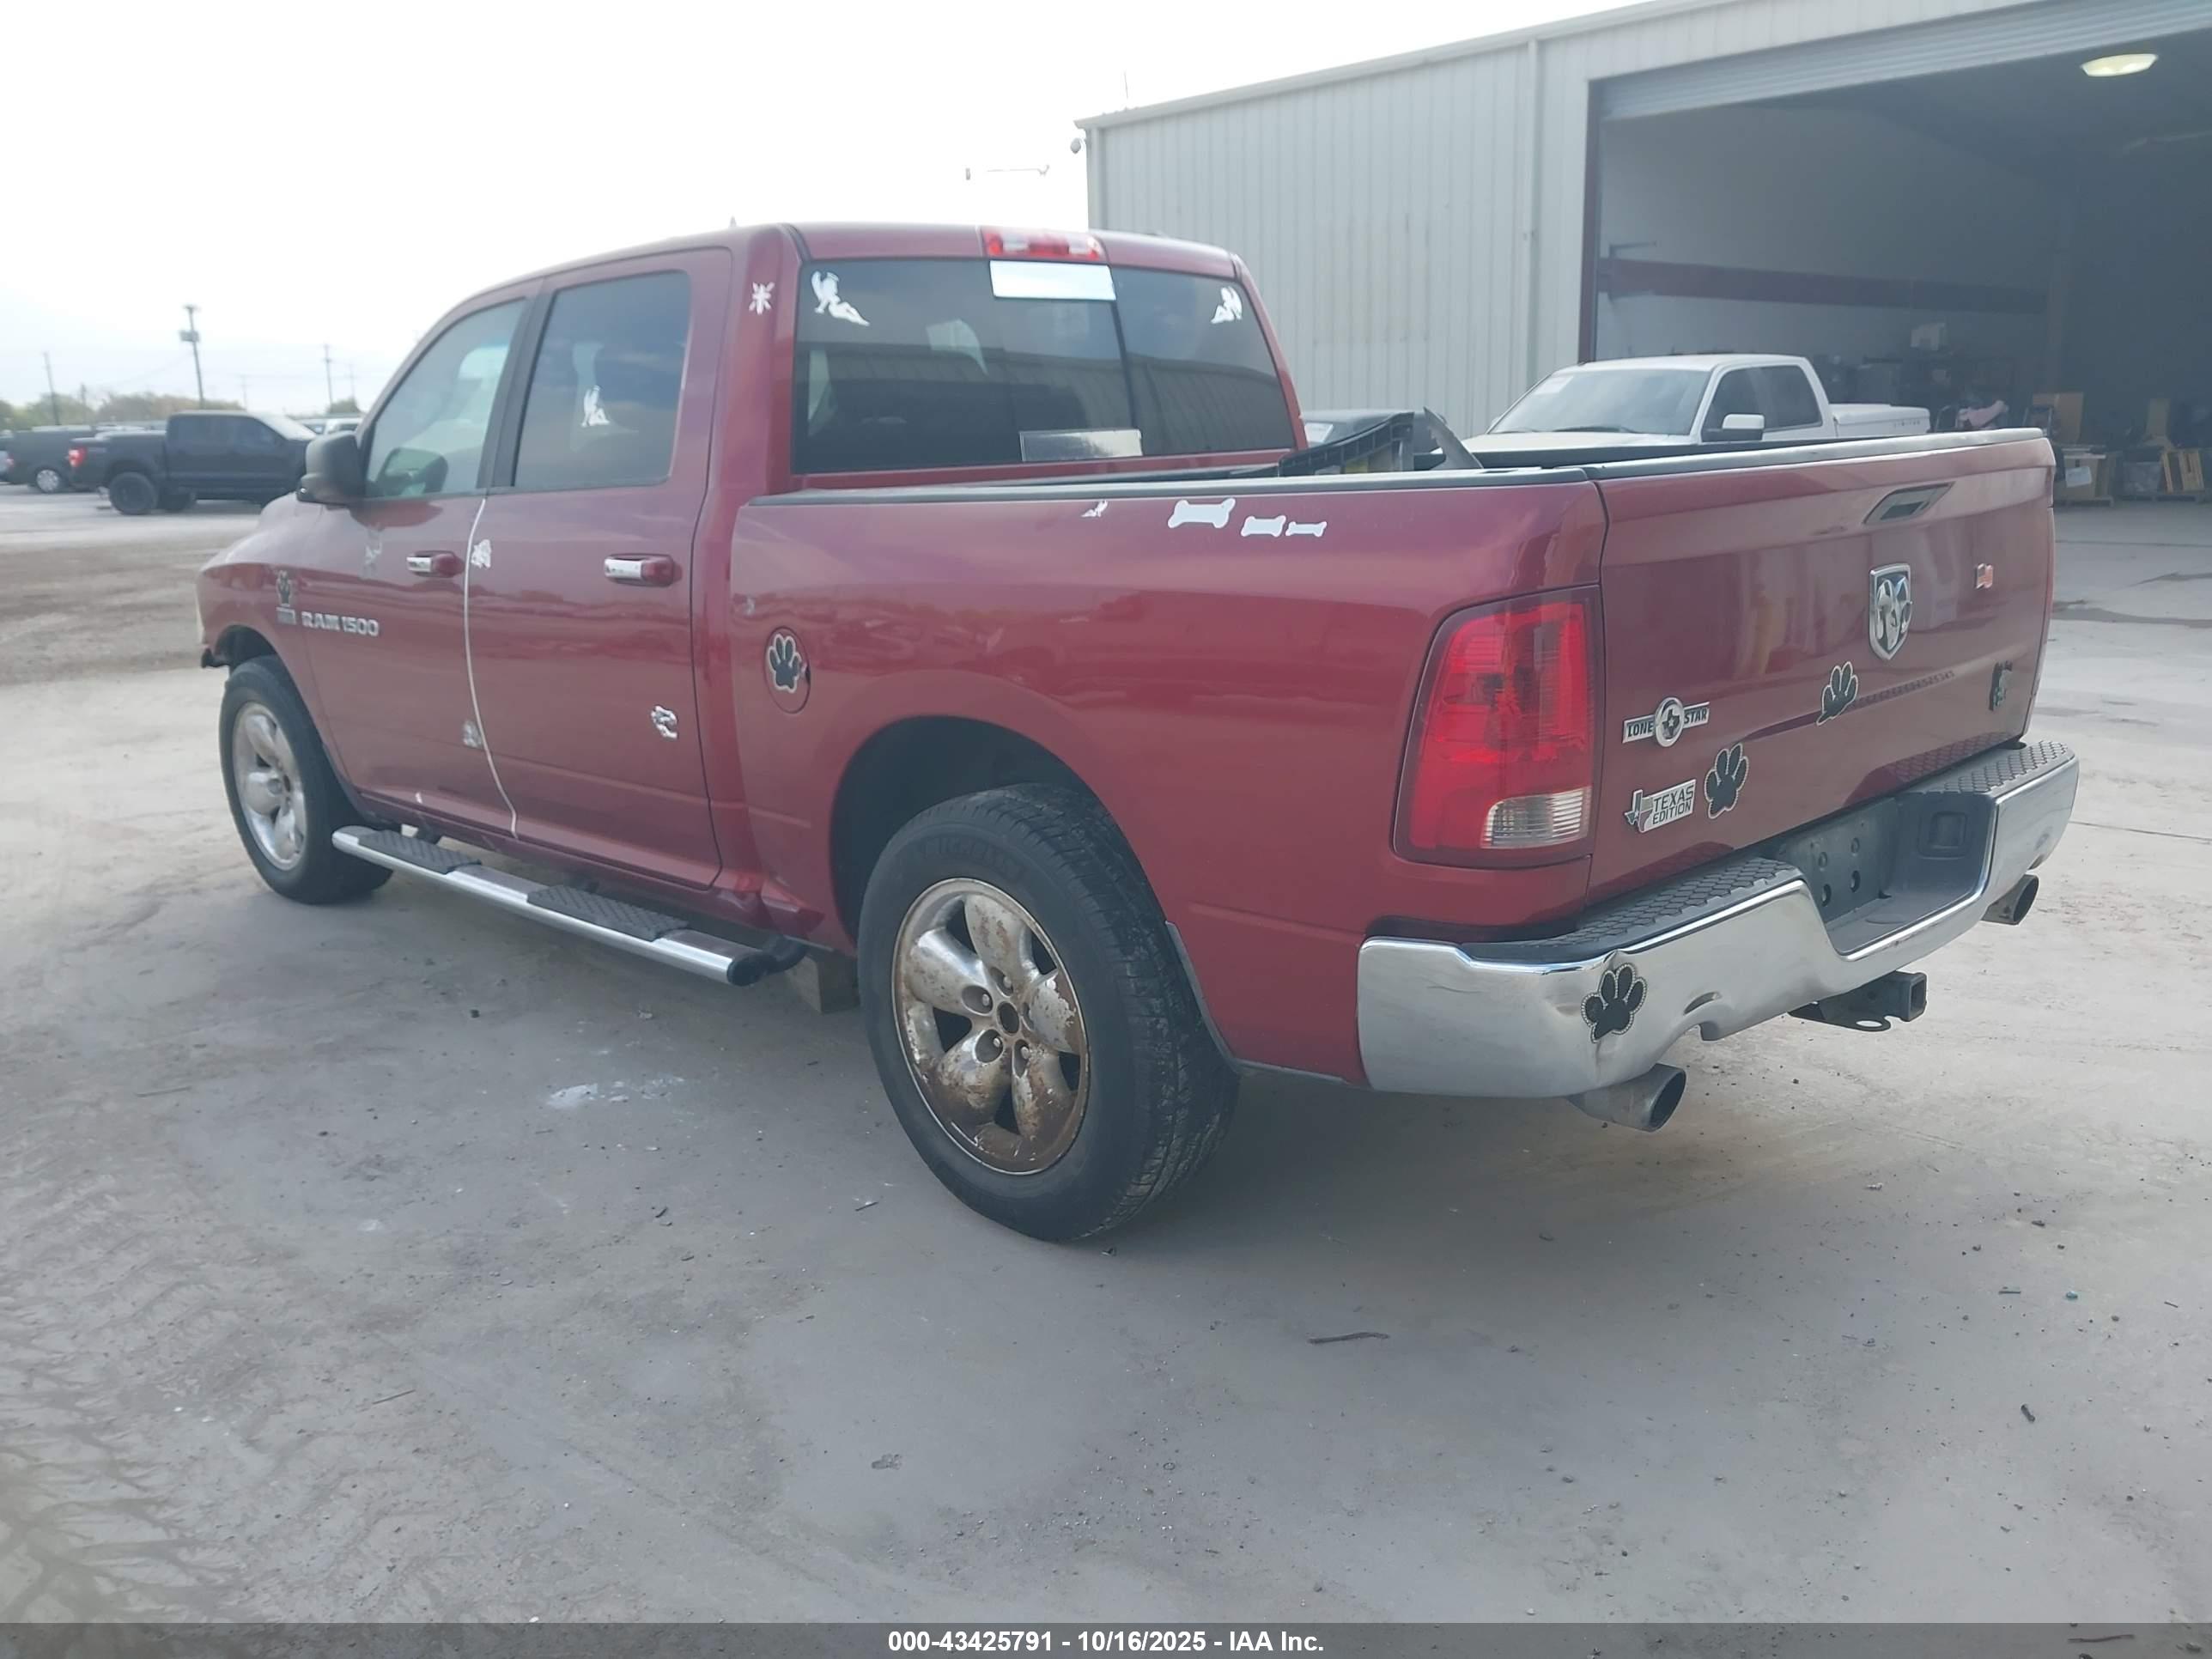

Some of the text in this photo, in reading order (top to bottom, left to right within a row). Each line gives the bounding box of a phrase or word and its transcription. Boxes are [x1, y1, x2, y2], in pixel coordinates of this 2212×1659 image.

[301, 611, 341, 632] RAM
[341, 616, 380, 637] 1500
[1627, 707, 1708, 738] LONE STAR
[1652, 785, 1694, 825] TEXAS EDITION
